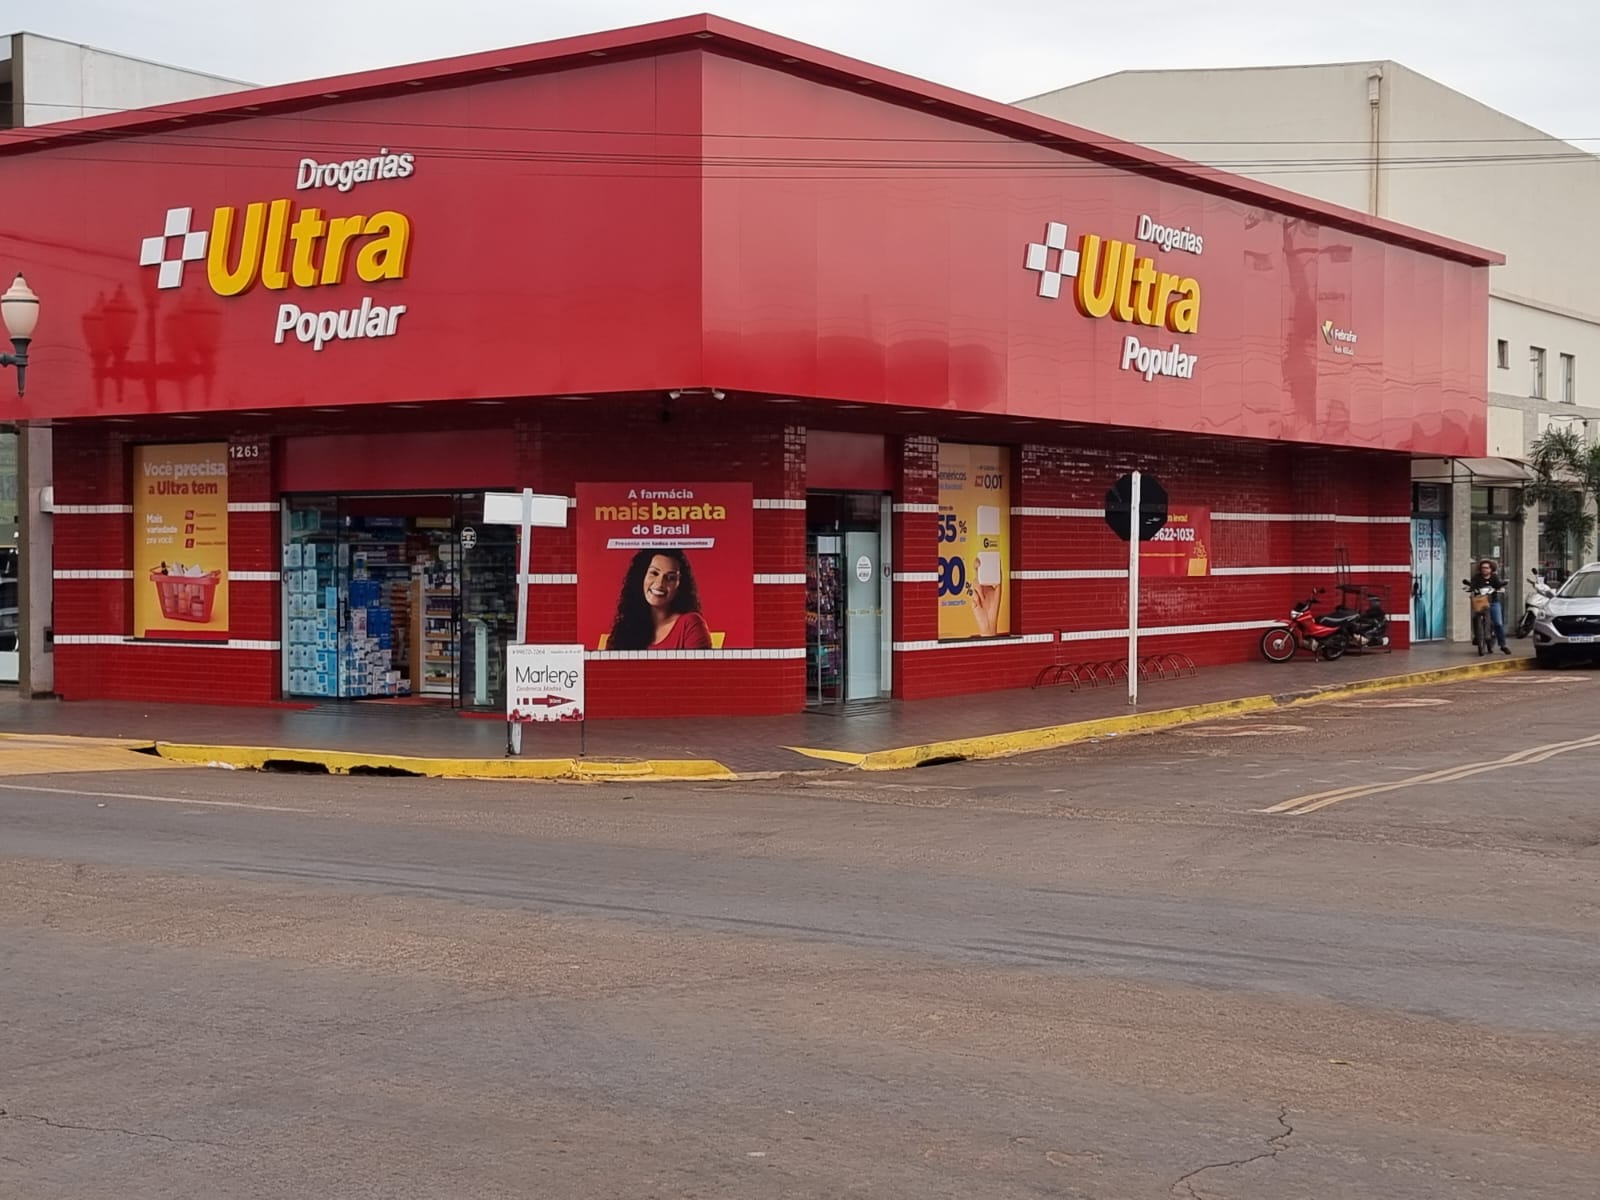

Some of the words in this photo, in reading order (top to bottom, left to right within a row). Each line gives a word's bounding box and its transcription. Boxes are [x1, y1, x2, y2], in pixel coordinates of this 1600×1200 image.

[296, 147, 414, 192] Drogarias
[1136, 214, 1204, 256] Drogarias
[206, 199, 411, 297] Ultra
[1073, 233, 1201, 335] Ultra
[274, 297, 406, 351] Popular
[1120, 335, 1199, 381] Popular
[230, 445, 259, 459] 1263
[143, 461, 172, 477] Você
[148, 485, 155, 495] a
[157, 480, 189, 496] Ultra
[192, 480, 218, 495] tem
[628, 489, 638, 499] A
[641, 488, 694, 499] farmácia
[595, 502, 650, 521] mais
[651, 502, 727, 521] barata
[632, 524, 650, 535] do
[653, 523, 691, 535] Brasil
[515, 664, 579, 689] Marlene
